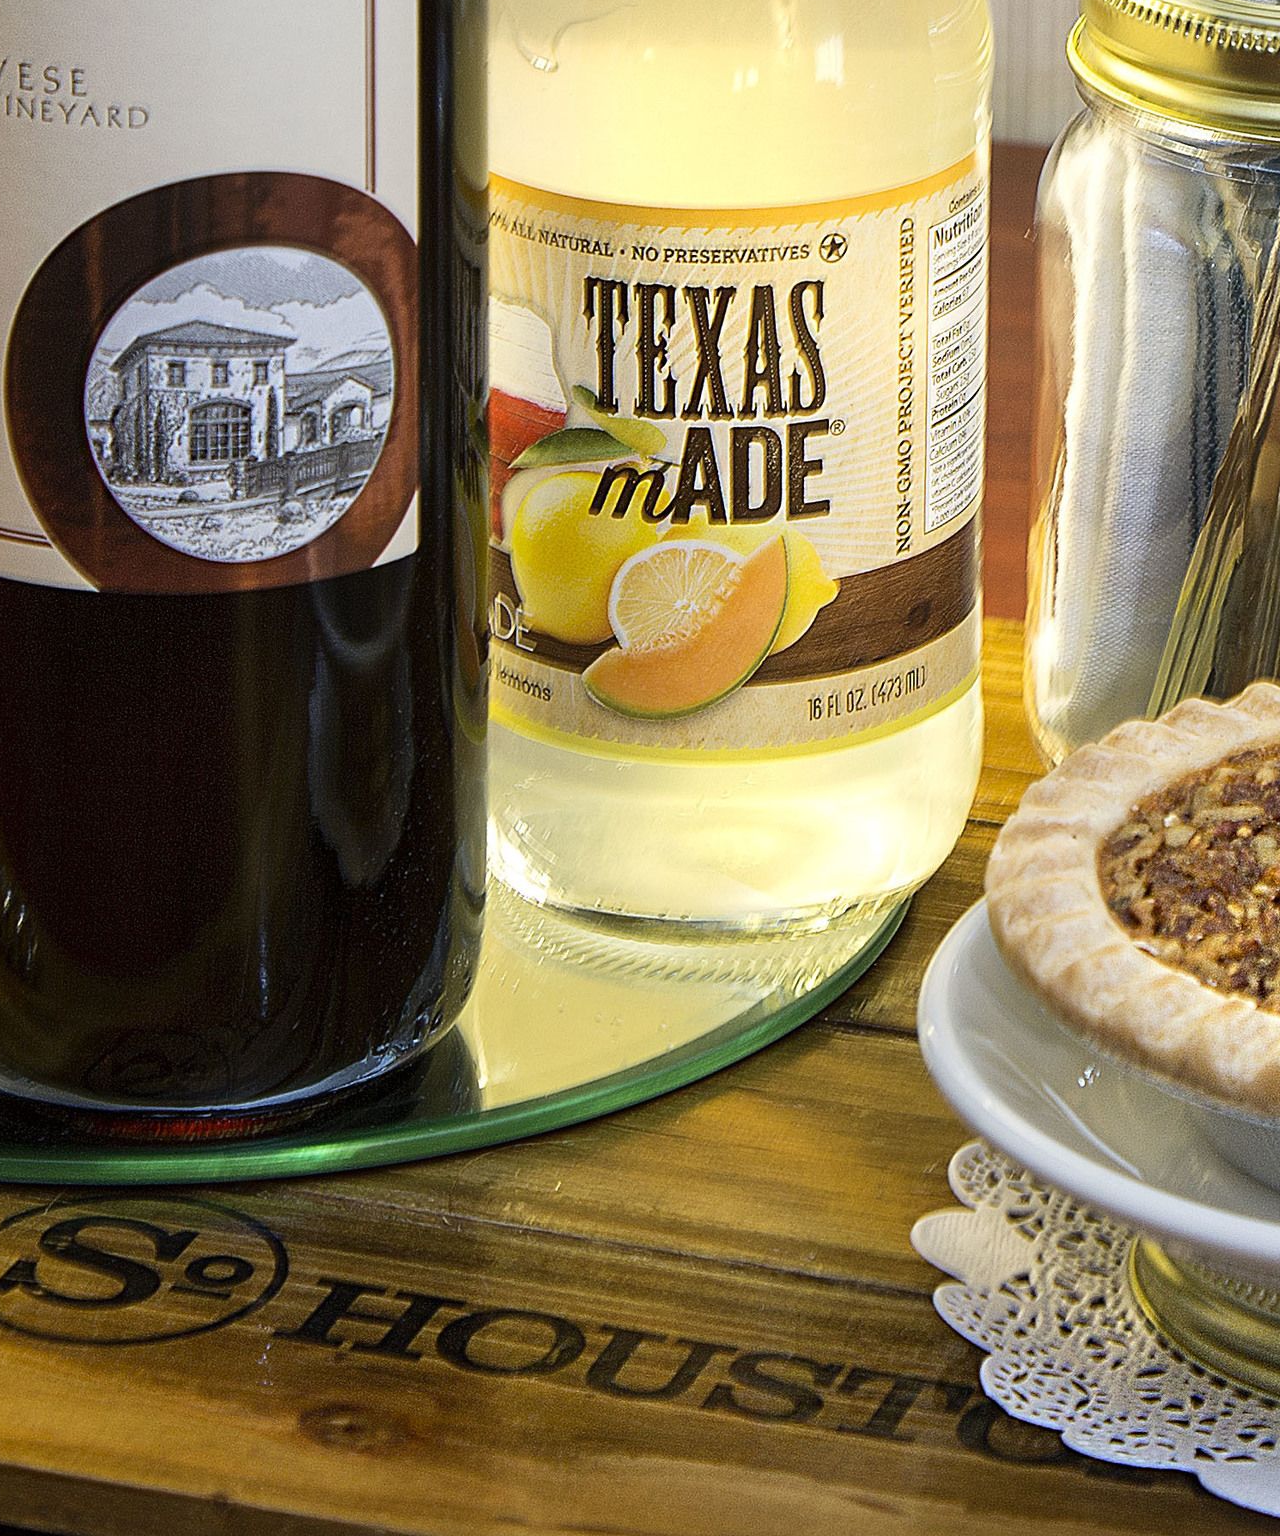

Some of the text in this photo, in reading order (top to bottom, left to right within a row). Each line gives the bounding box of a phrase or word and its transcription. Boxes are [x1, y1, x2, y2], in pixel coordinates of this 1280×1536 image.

[510, 221, 810, 265] ALL NATURAL NO PRESERVATIVES
[933, 203, 982, 249] Nutrition
[932, 294, 962, 317] Calories
[582, 275, 827, 421] TEXAS
[931, 331, 951, 350] Total
[896, 217, 915, 556] NON-GMO PROJECT VERIFIED
[931, 366, 951, 386] Total
[931, 399, 959, 420] Protein
[588, 418, 831, 527] mADE
[807, 665, 927, 722] 16 FL OZ. (473 ML)
[273, 1276, 1120, 1479] HOUSTO
